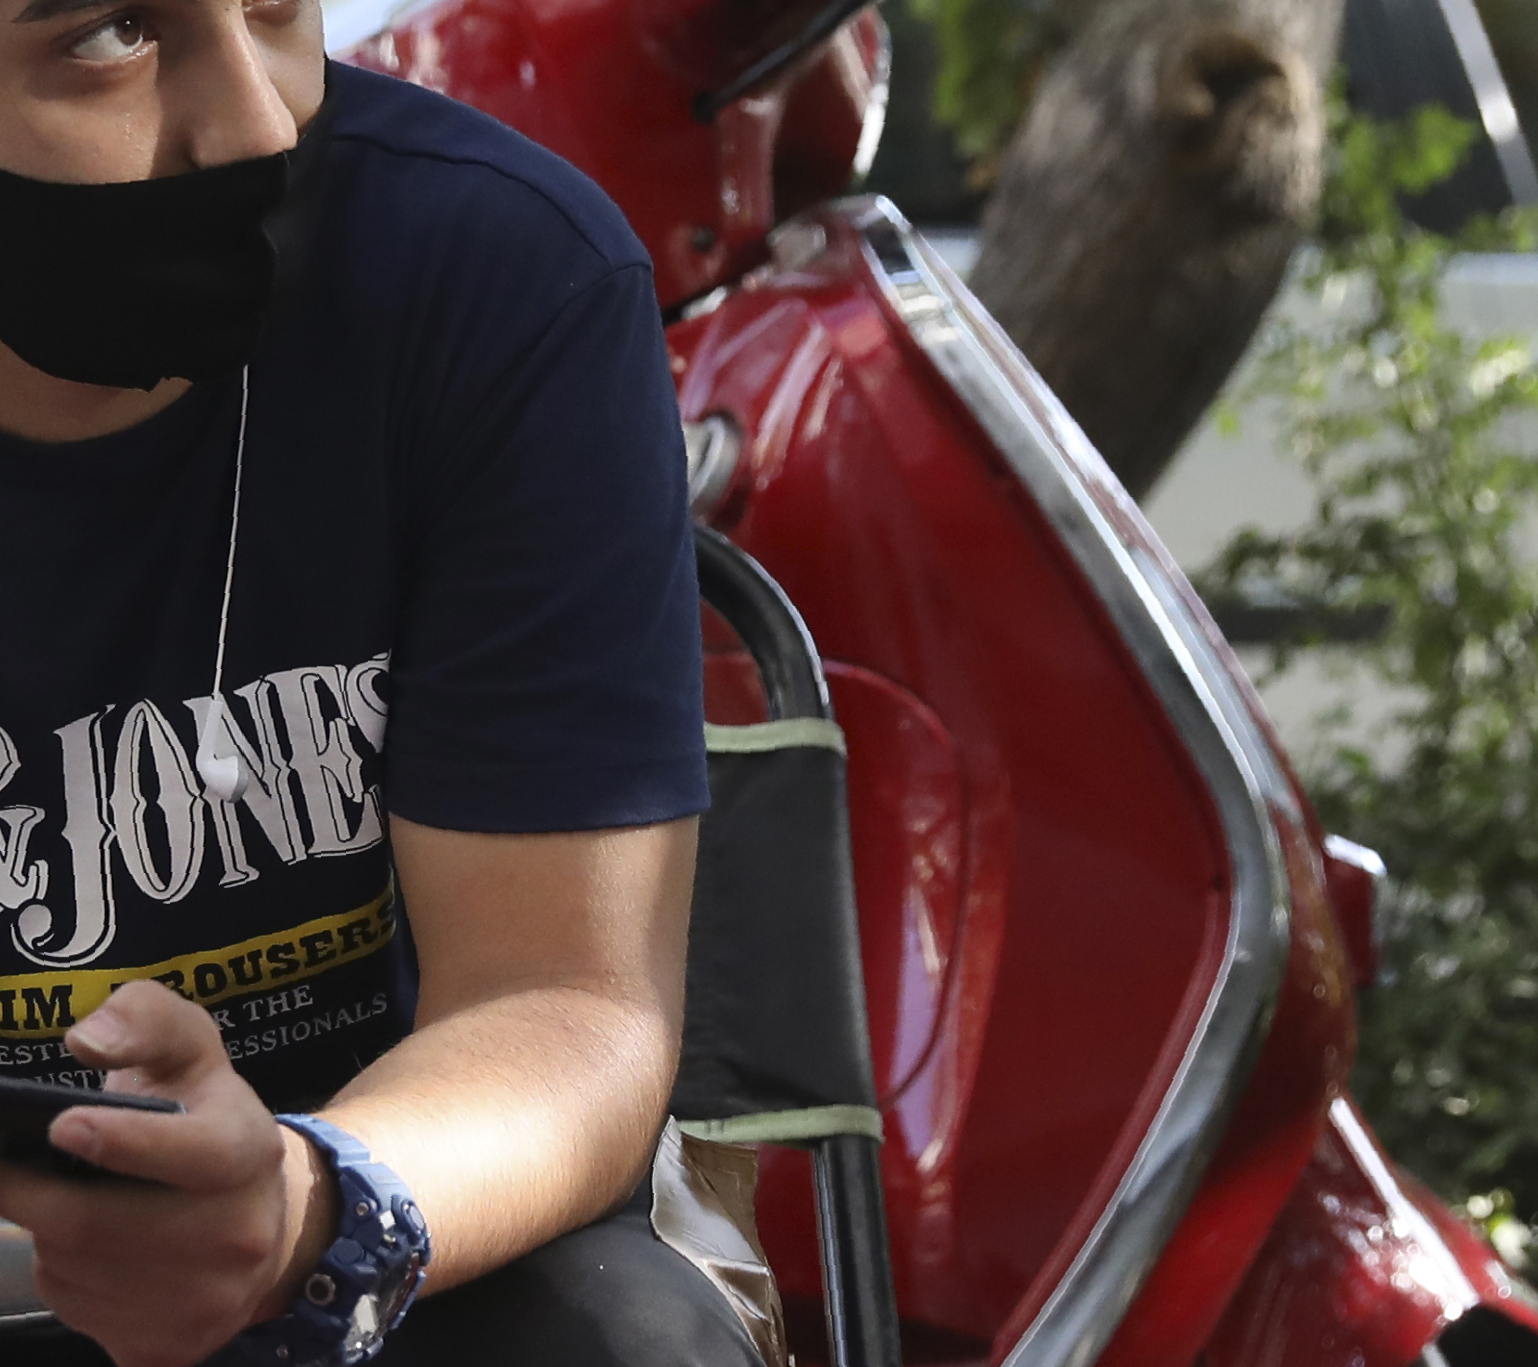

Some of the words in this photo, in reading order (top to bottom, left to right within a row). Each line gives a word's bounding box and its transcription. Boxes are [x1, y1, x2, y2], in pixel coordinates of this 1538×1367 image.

[110, 903, 394, 1001] ROUSERS
[226, 993, 388, 1060] ESSIONALS
[243, 984, 314, 1021] THE
